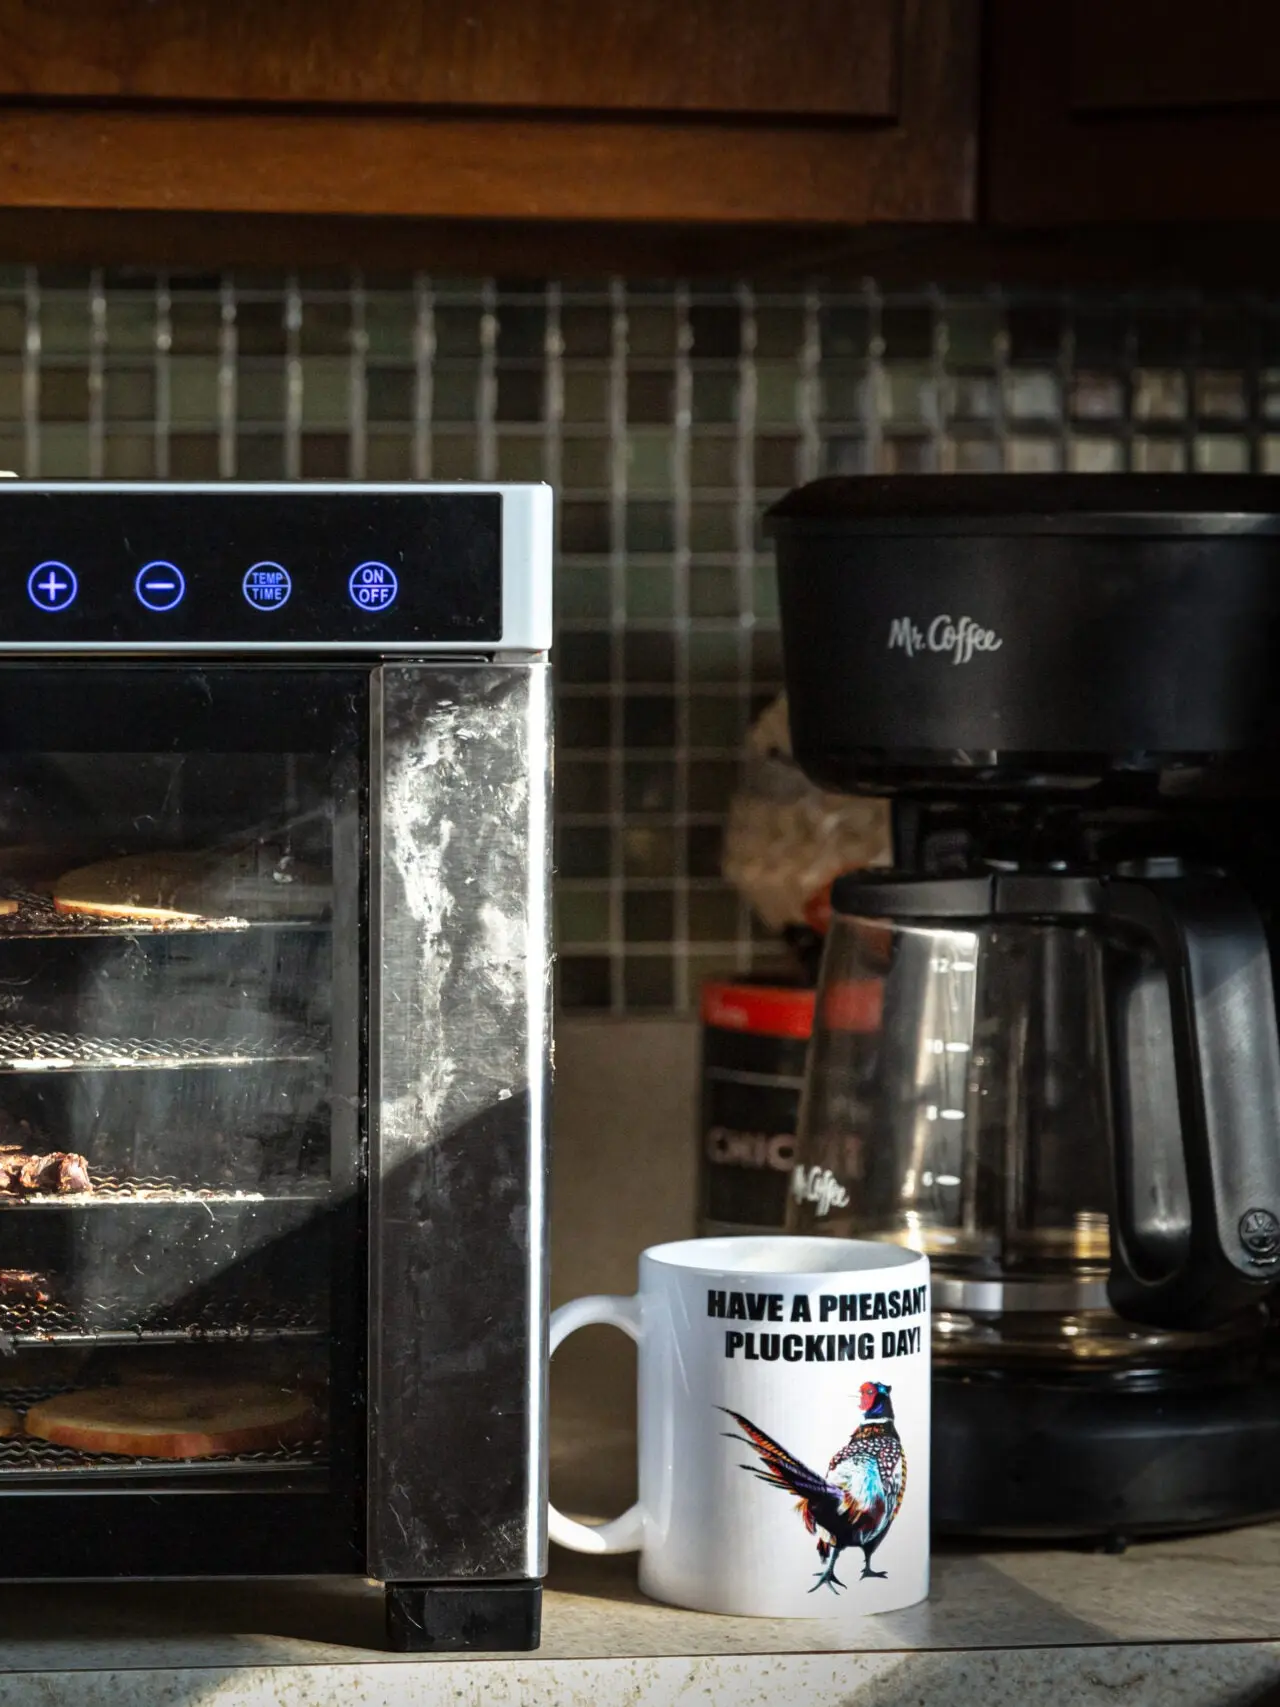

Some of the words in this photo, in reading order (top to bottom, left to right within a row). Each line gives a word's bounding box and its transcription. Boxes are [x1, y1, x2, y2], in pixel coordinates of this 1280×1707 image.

[251, 572, 283, 585] TEMP
[362, 569, 384, 583] ON
[251, 588, 282, 600] TIME
[358, 589, 389, 603] OFF
[927, 614, 1004, 665] Coffee
[707, 1289, 784, 1322] HAVE
[790, 1294, 812, 1322] A
[819, 1285, 927, 1322] PHEASANT
[725, 1330, 874, 1362] PLUCKING
[882, 1326, 921, 1358] DAY!
